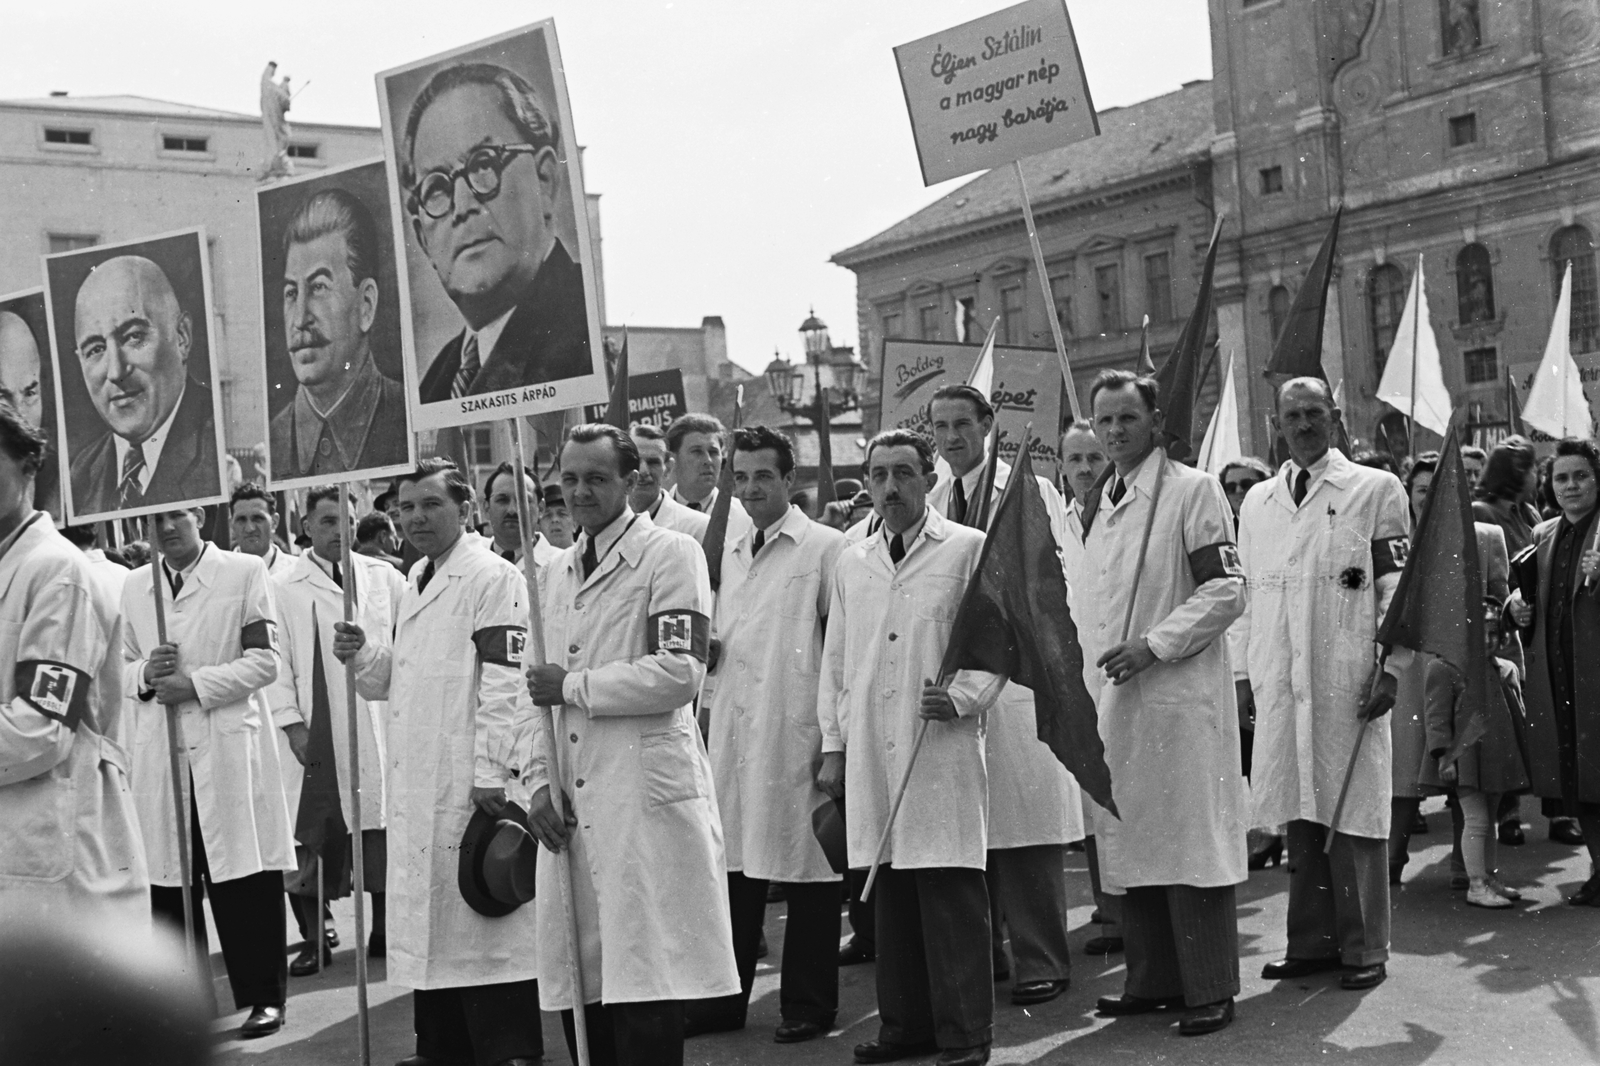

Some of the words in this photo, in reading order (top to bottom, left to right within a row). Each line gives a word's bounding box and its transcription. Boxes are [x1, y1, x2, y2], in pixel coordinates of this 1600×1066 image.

[931, 43, 977, 85] Éljen
[981, 25, 1042, 61] Sztálin
[939, 96, 951, 111] a
[956, 73, 1025, 103] magyar
[1028, 57, 1060, 85] nép
[950, 122, 999, 145] nagy
[1002, 97, 1069, 129] barátja
[896, 356, 944, 387] Boldog
[461, 392, 518, 413] SZAKASITS
[522, 384, 557, 403] ÁRPÁD
